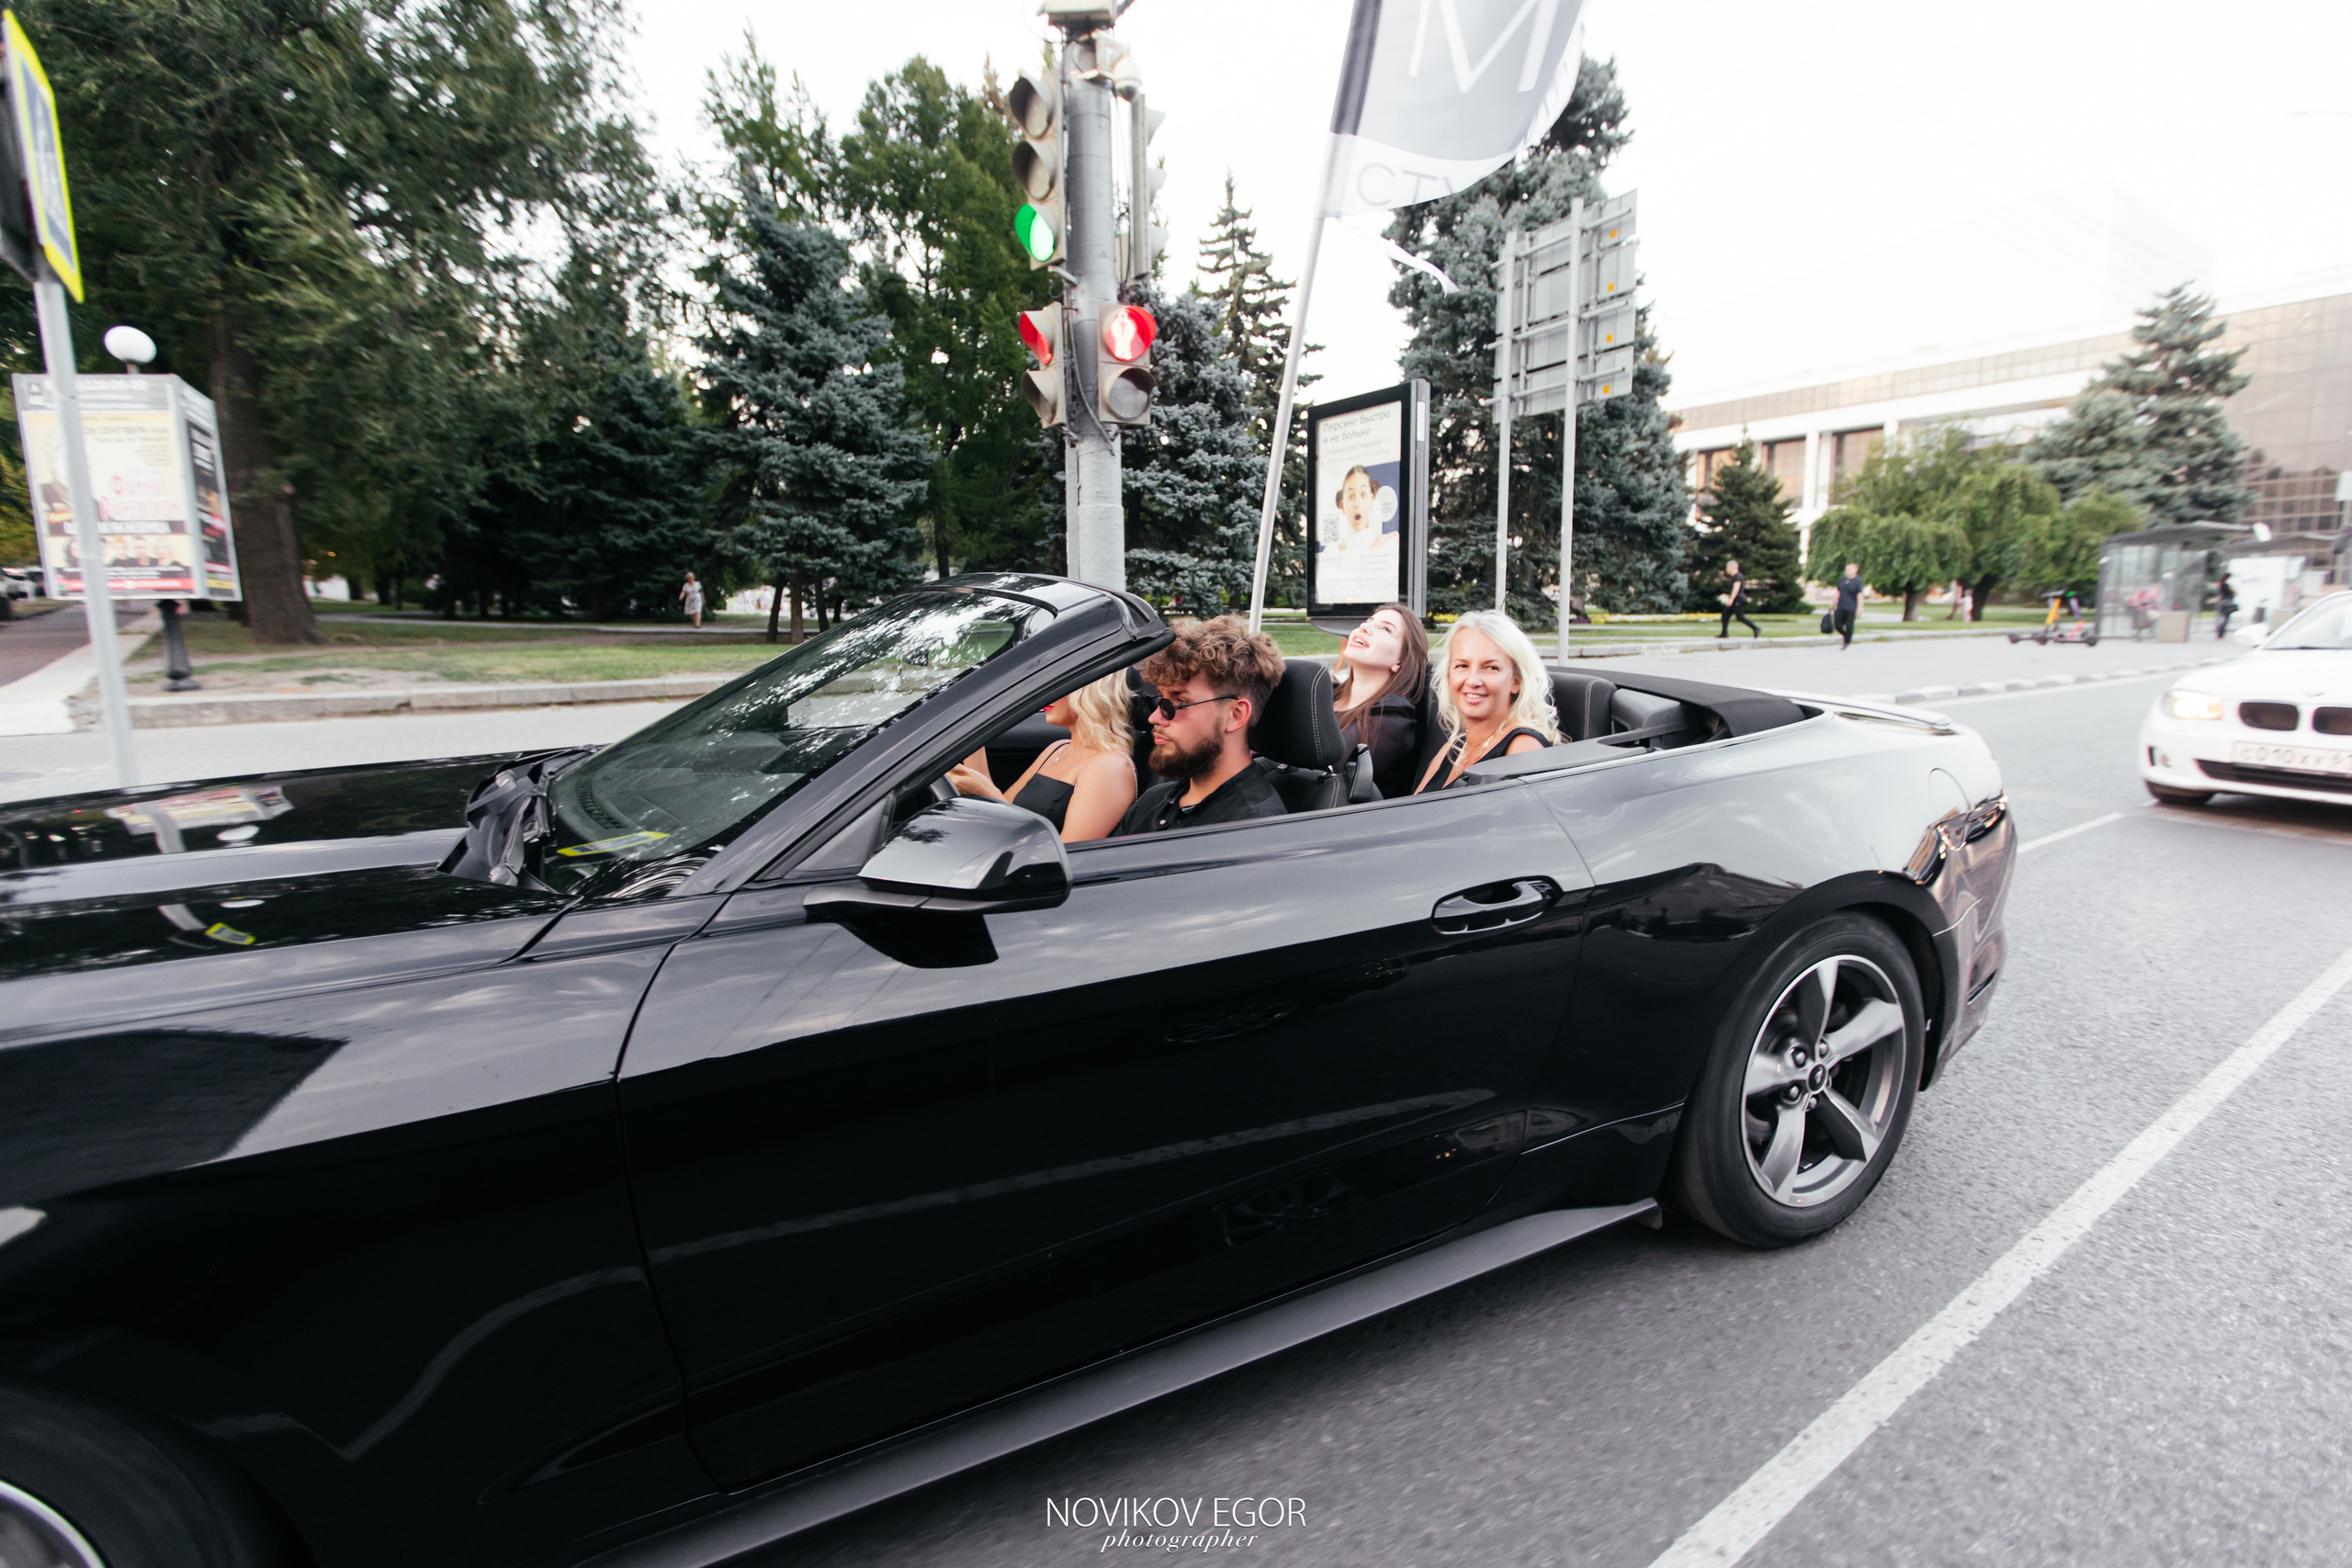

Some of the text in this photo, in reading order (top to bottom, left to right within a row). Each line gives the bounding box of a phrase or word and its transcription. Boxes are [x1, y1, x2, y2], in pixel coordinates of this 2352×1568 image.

[1323, 410, 1391, 433] Пирсинг быстро
[1329, 434, 1340, 444] не
[1341, 427, 1372, 441] больно
